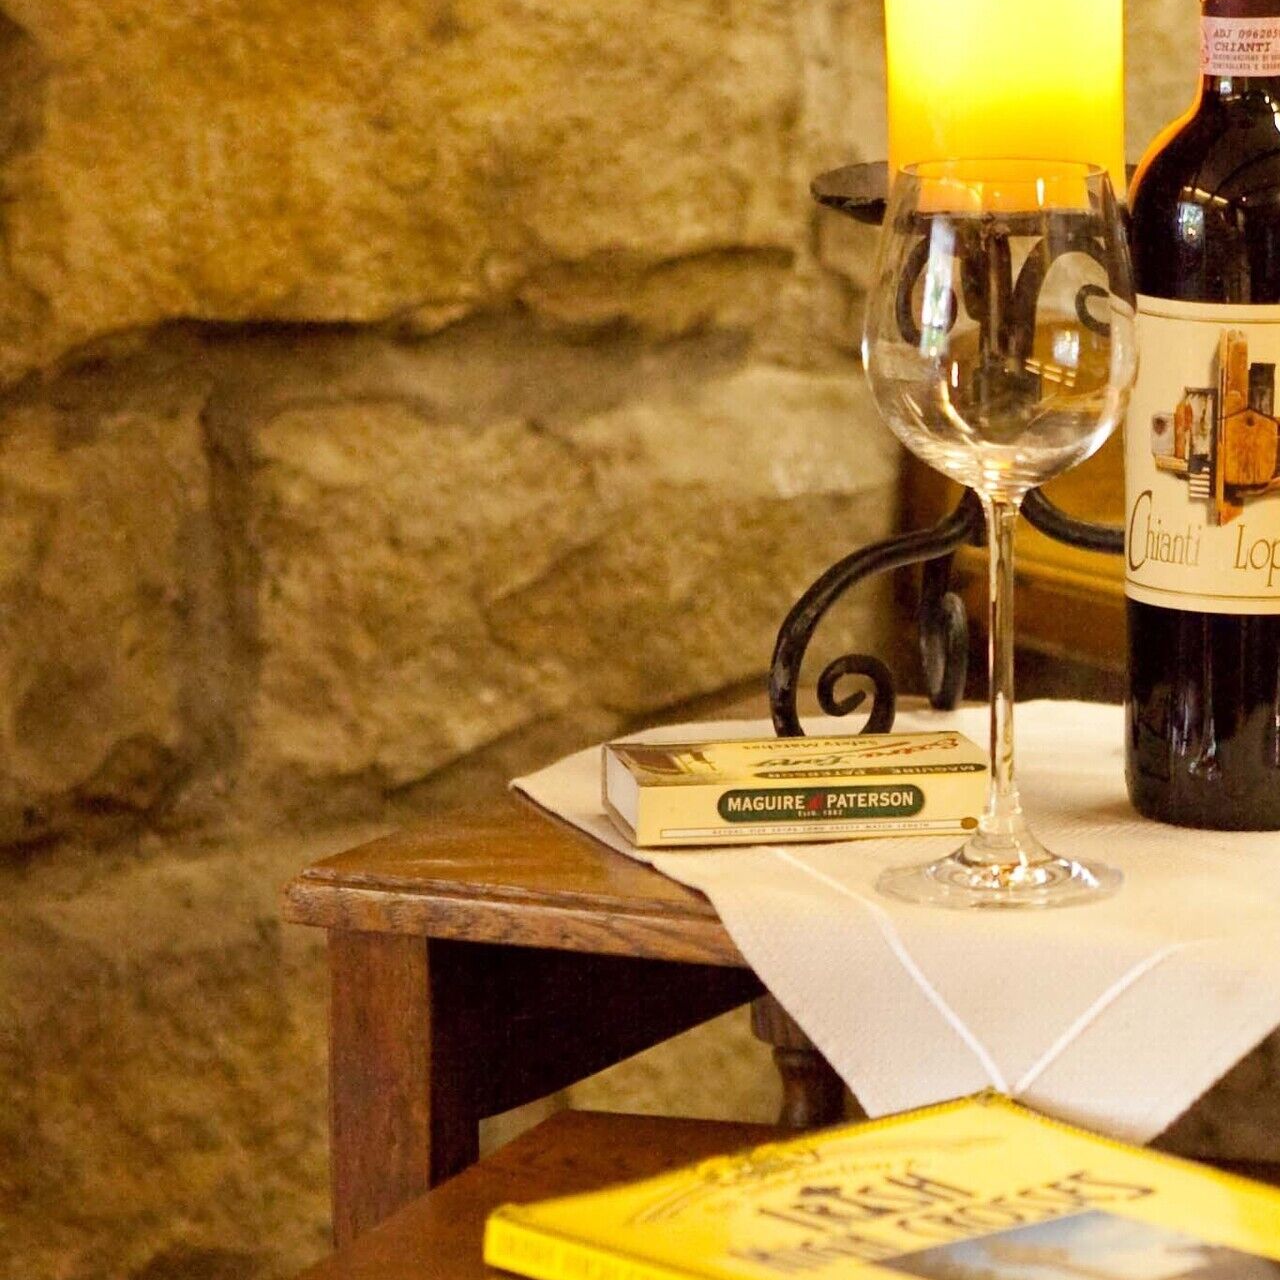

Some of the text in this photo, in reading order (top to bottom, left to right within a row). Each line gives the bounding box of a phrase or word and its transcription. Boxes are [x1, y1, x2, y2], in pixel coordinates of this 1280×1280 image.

[1214, 41, 1272, 53] CHIANTI
[1128, 489, 1202, 572] Chianti
[727, 791, 914, 812] MAGUIRE PATERSON
[757, 1171, 974, 1233] IRISH
[895, 1170, 1156, 1236] CROSSES
